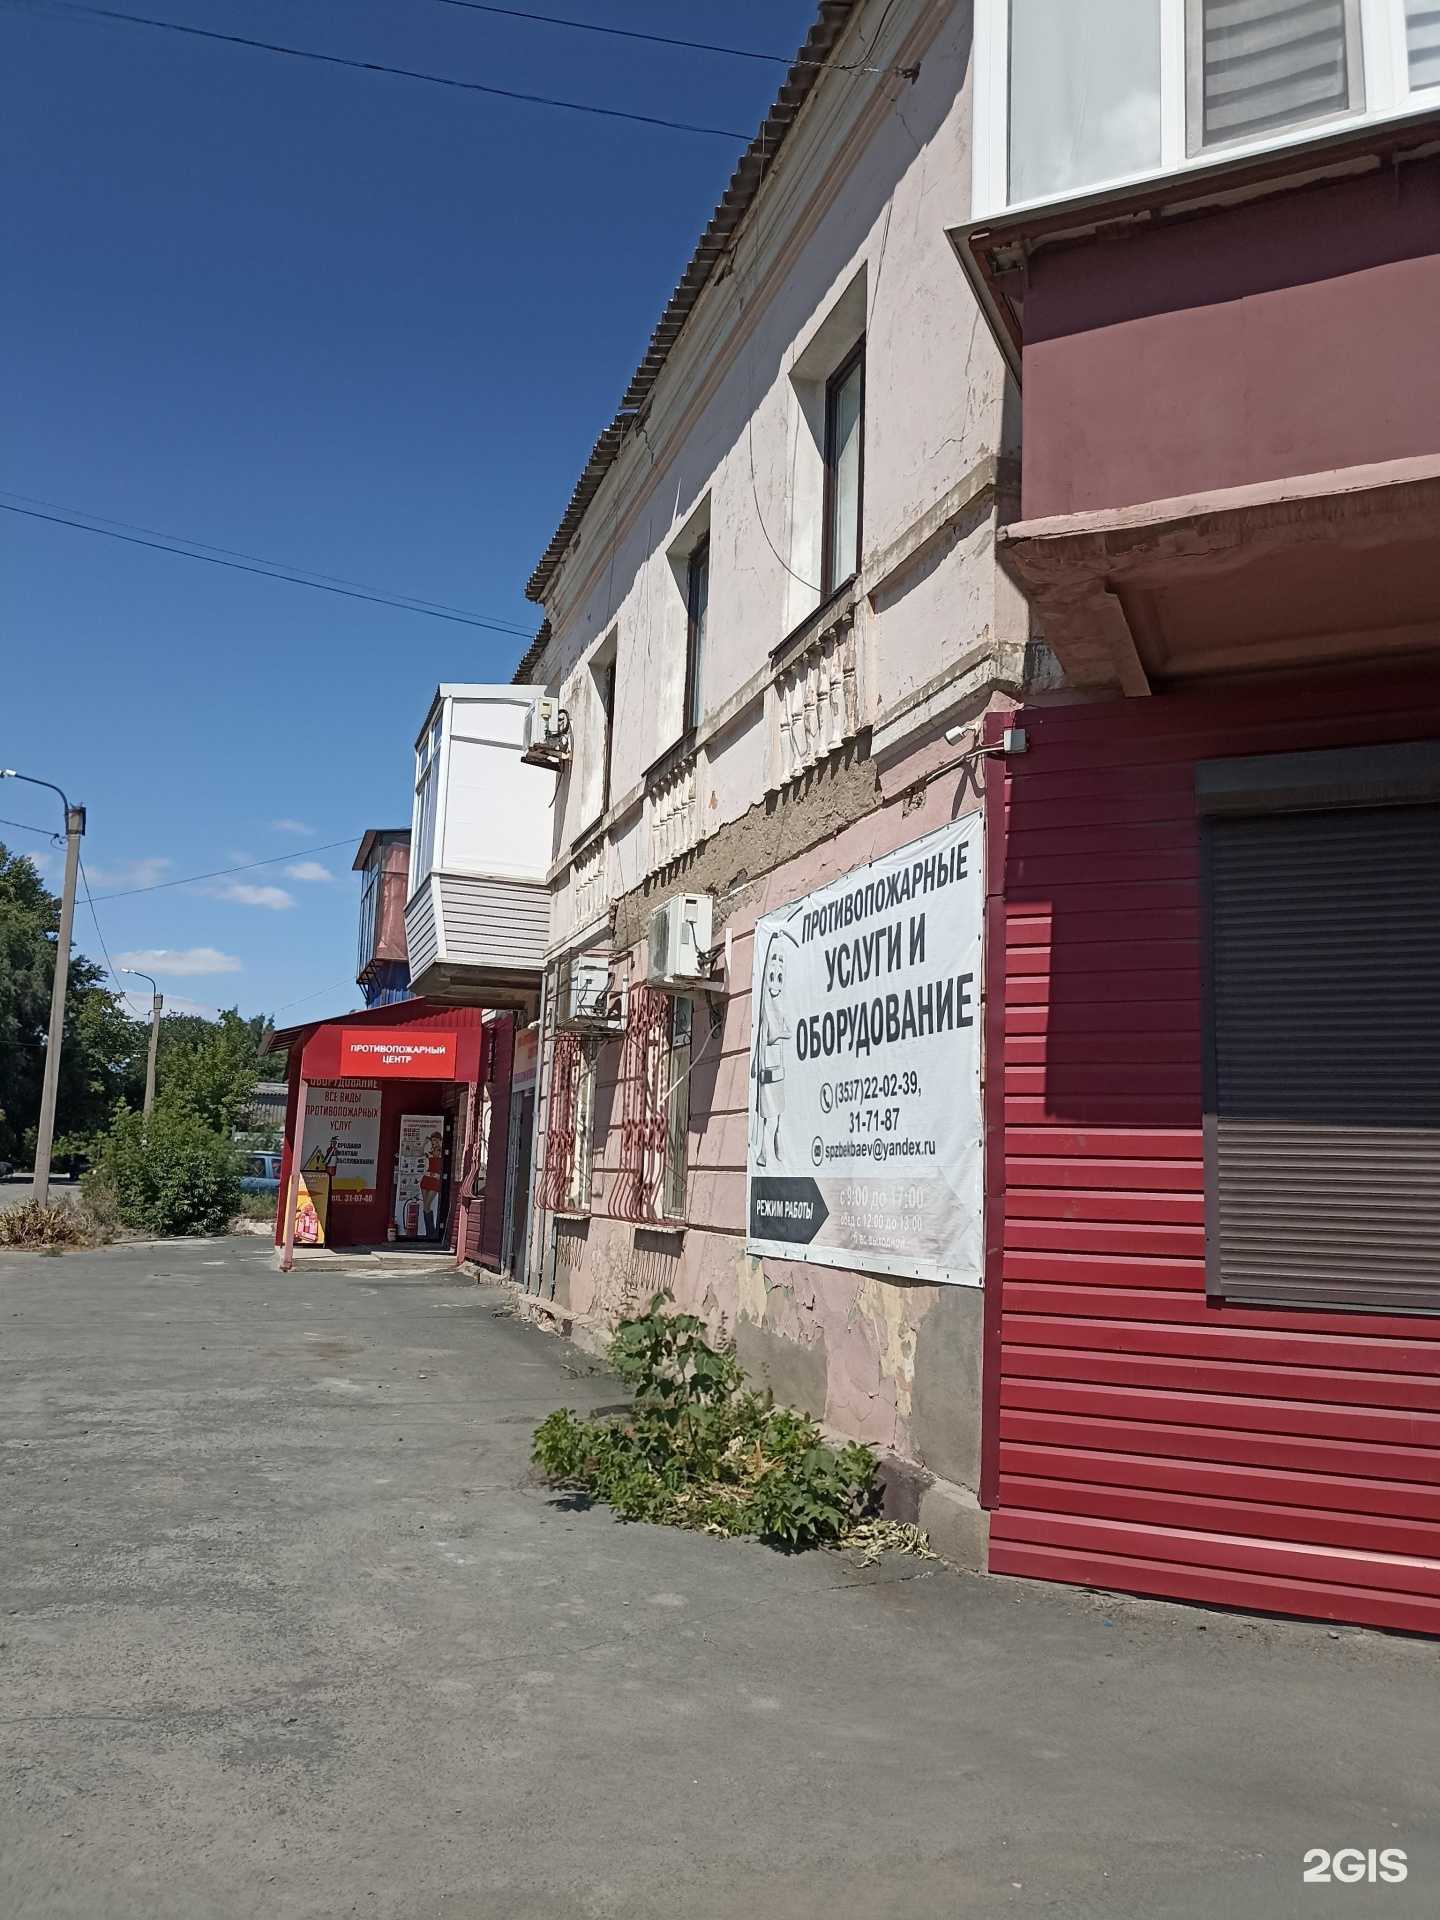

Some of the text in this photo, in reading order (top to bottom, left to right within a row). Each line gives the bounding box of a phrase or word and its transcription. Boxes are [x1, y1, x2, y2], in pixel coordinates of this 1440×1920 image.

[802, 841, 969, 944] ПРОТИВОПОЖАРНЫЕ
[824, 912, 926, 993] УСЛУГИ И
[796, 972, 974, 1061] ОБОРУДОВАНИЕ
[350, 1043, 446, 1055] ПРОТИВОПОЖАРНЫЙ
[382, 1055, 412, 1064] ЦЕНТР
[849, 1107, 900, 1133] 31-71-87
[756, 1199, 814, 1219] РЕЖИМ РАБОТЫ
